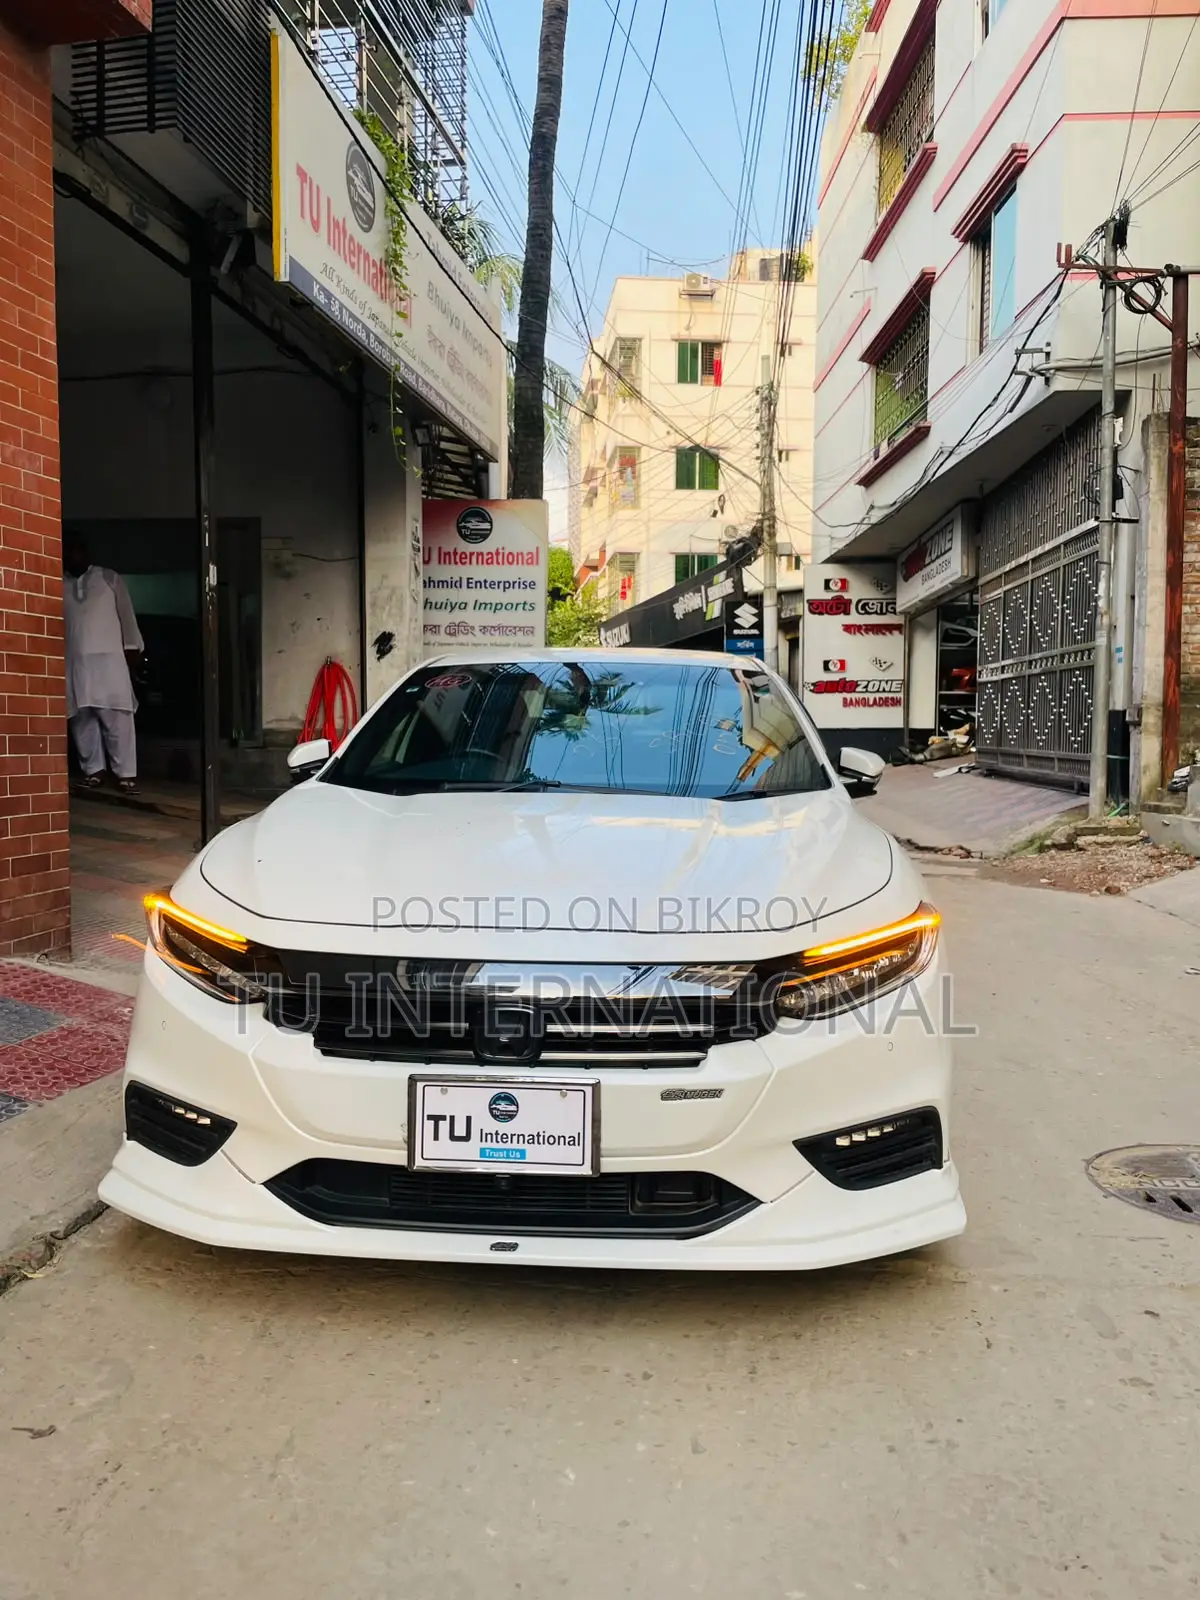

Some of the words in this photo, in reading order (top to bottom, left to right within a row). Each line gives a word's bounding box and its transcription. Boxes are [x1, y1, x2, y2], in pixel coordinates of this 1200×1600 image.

[296, 163, 321, 234] TU
[423, 546, 431, 565] U
[438, 546, 540, 566] International
[466, 577, 537, 592] Enterprise
[423, 598, 467, 613] huiya
[473, 600, 536, 613] Imports
[842, 697, 902, 708] BANGLADESH
[426, 1114, 472, 1142] TU
[479, 1128, 581, 1147] International
[485, 1149, 507, 1158] Trust
[509, 1149, 521, 1159] Us
